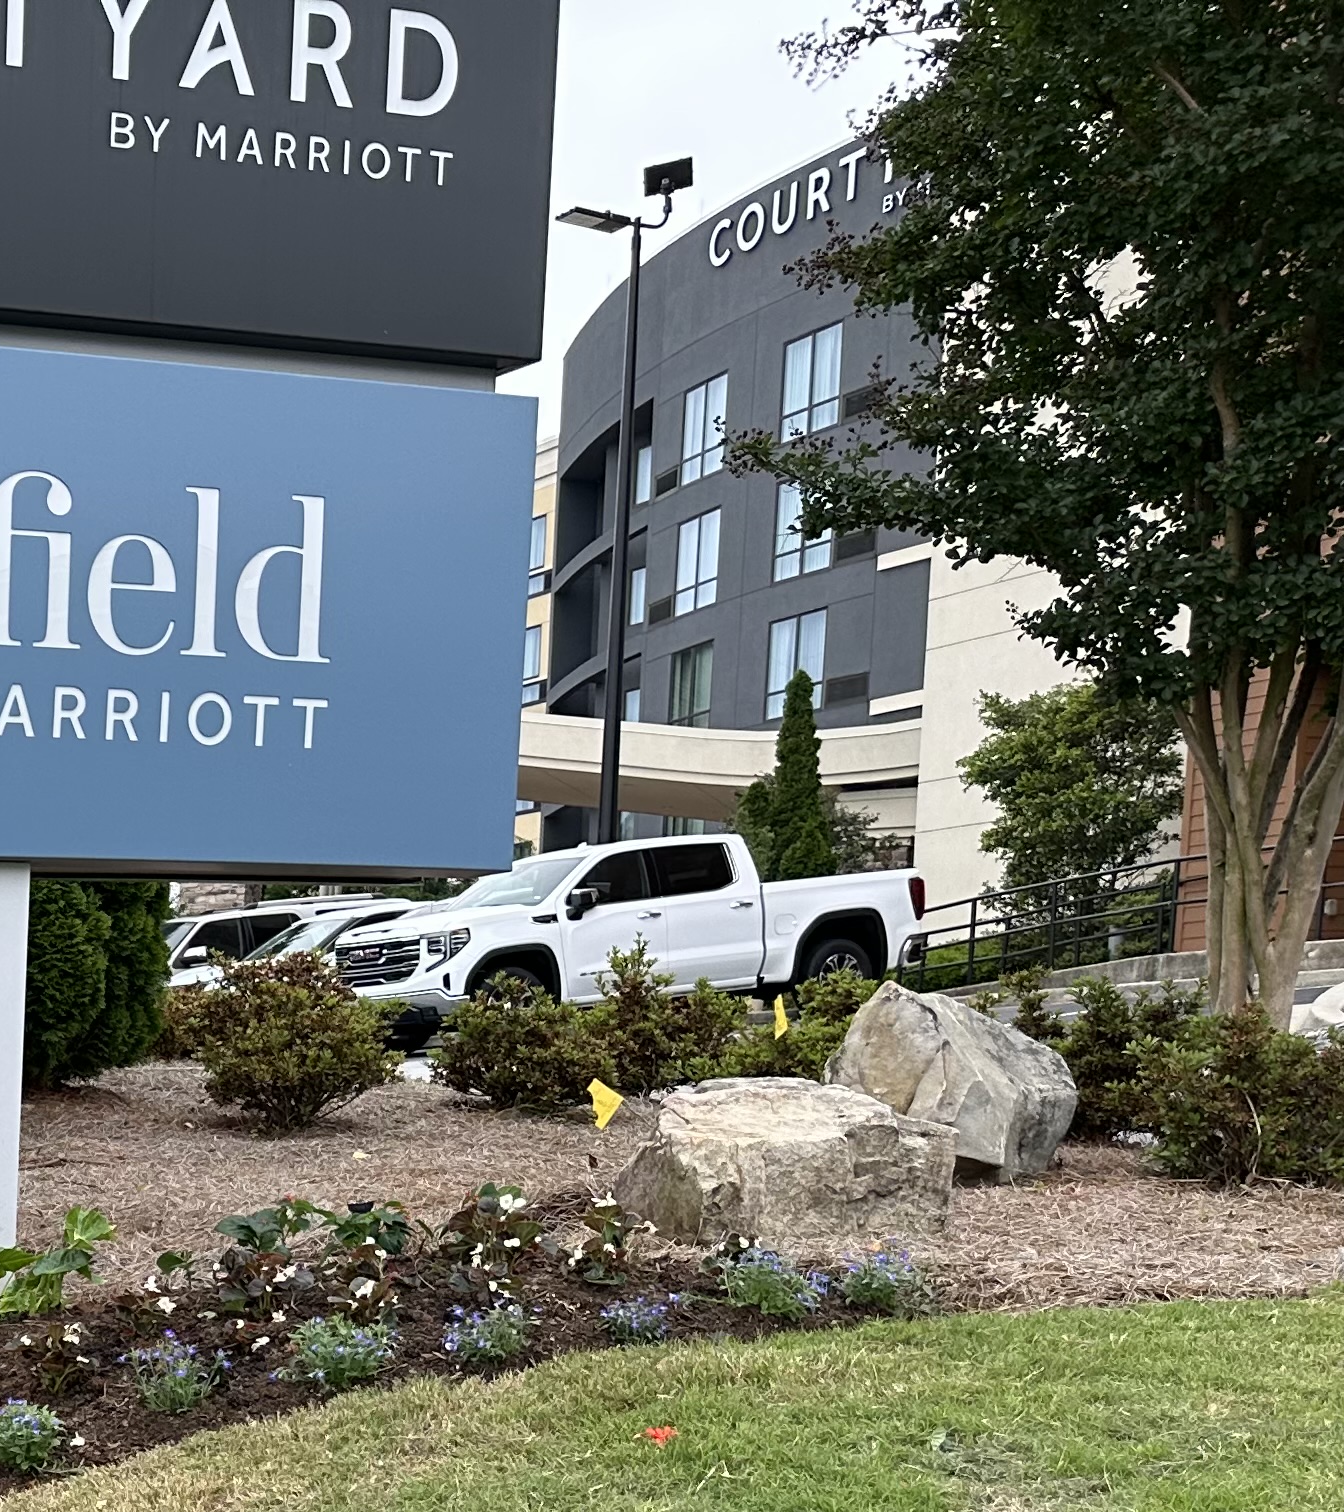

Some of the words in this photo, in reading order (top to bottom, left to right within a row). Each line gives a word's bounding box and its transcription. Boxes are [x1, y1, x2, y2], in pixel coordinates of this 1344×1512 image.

[109, 111, 171, 153] BY
[194, 121, 455, 187] MARRIOTT
[708, 146, 894, 268] COURT
[882, 187, 908, 214] BY
